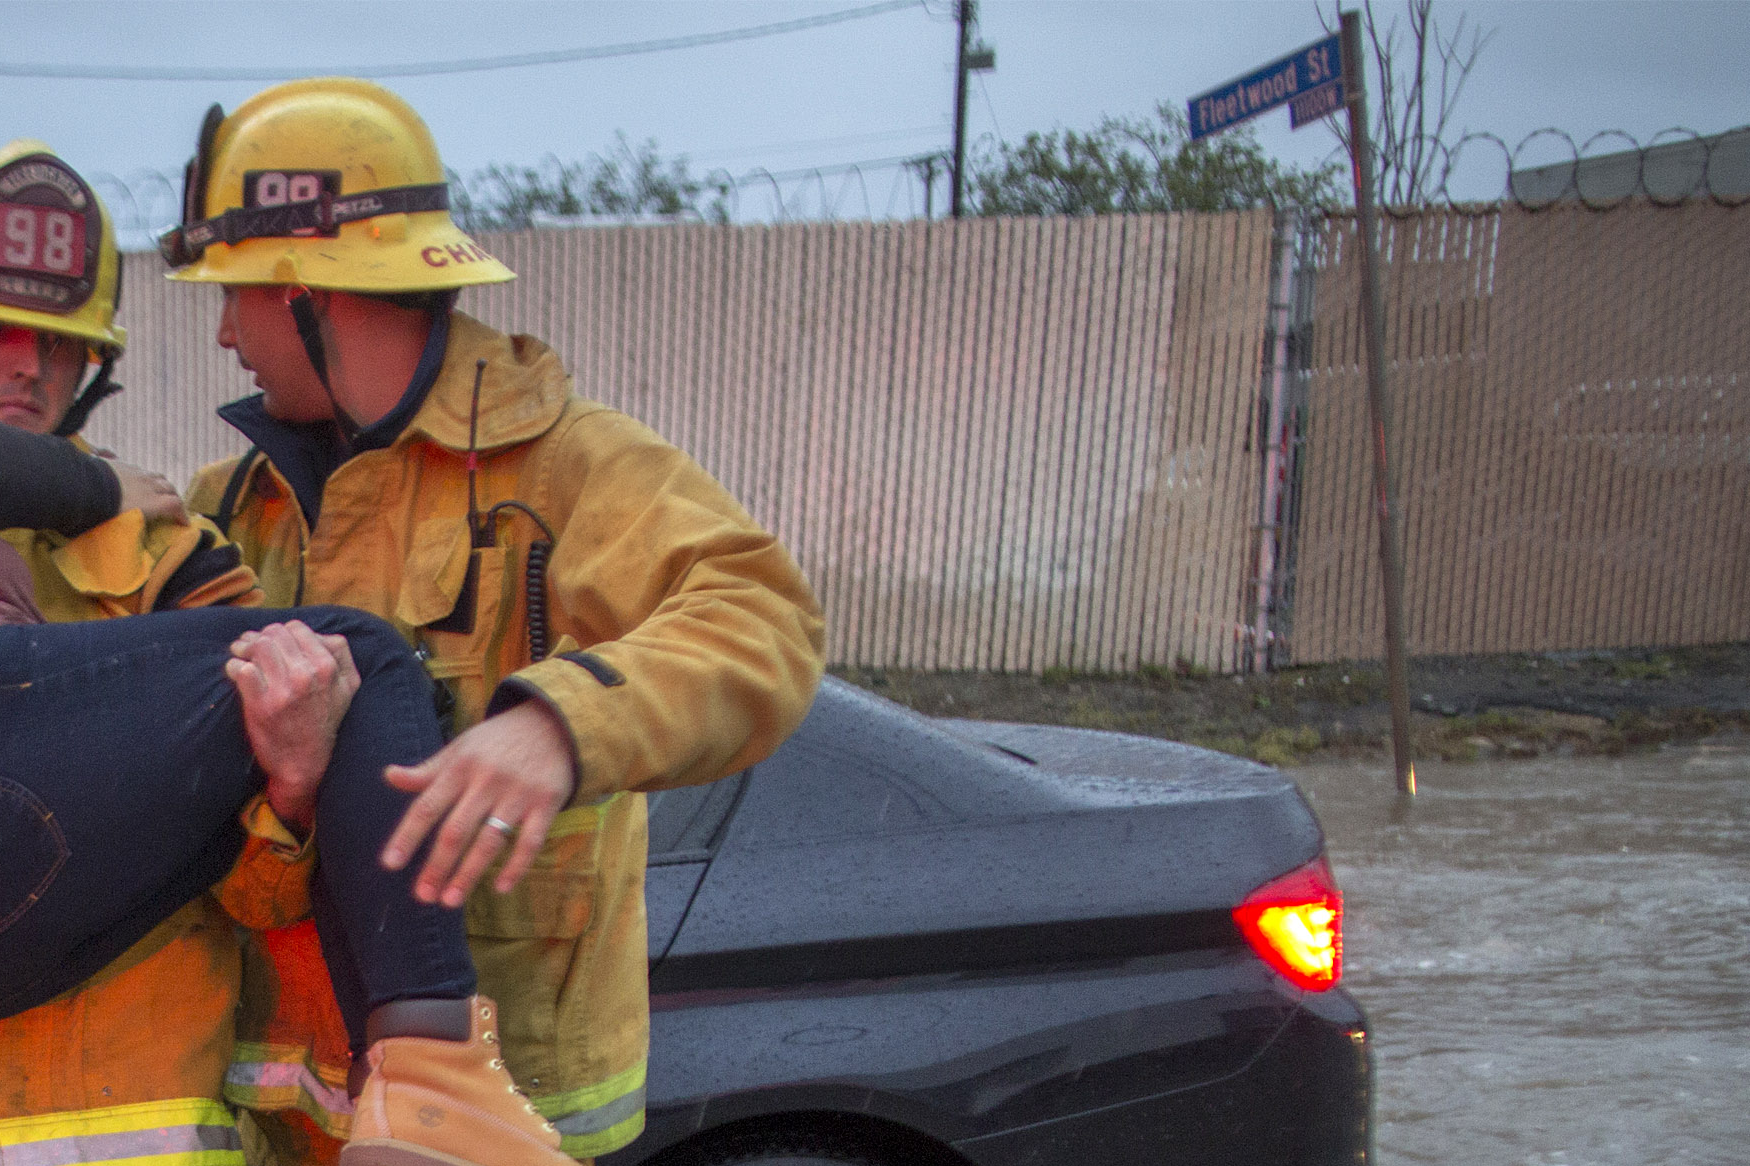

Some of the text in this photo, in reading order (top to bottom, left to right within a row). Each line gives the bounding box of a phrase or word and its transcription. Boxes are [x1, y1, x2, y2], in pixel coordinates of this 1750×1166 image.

[1198, 62, 1298, 131] Fleetwood
[1307, 47, 1331, 82] St
[3, 207, 75, 272] 98
